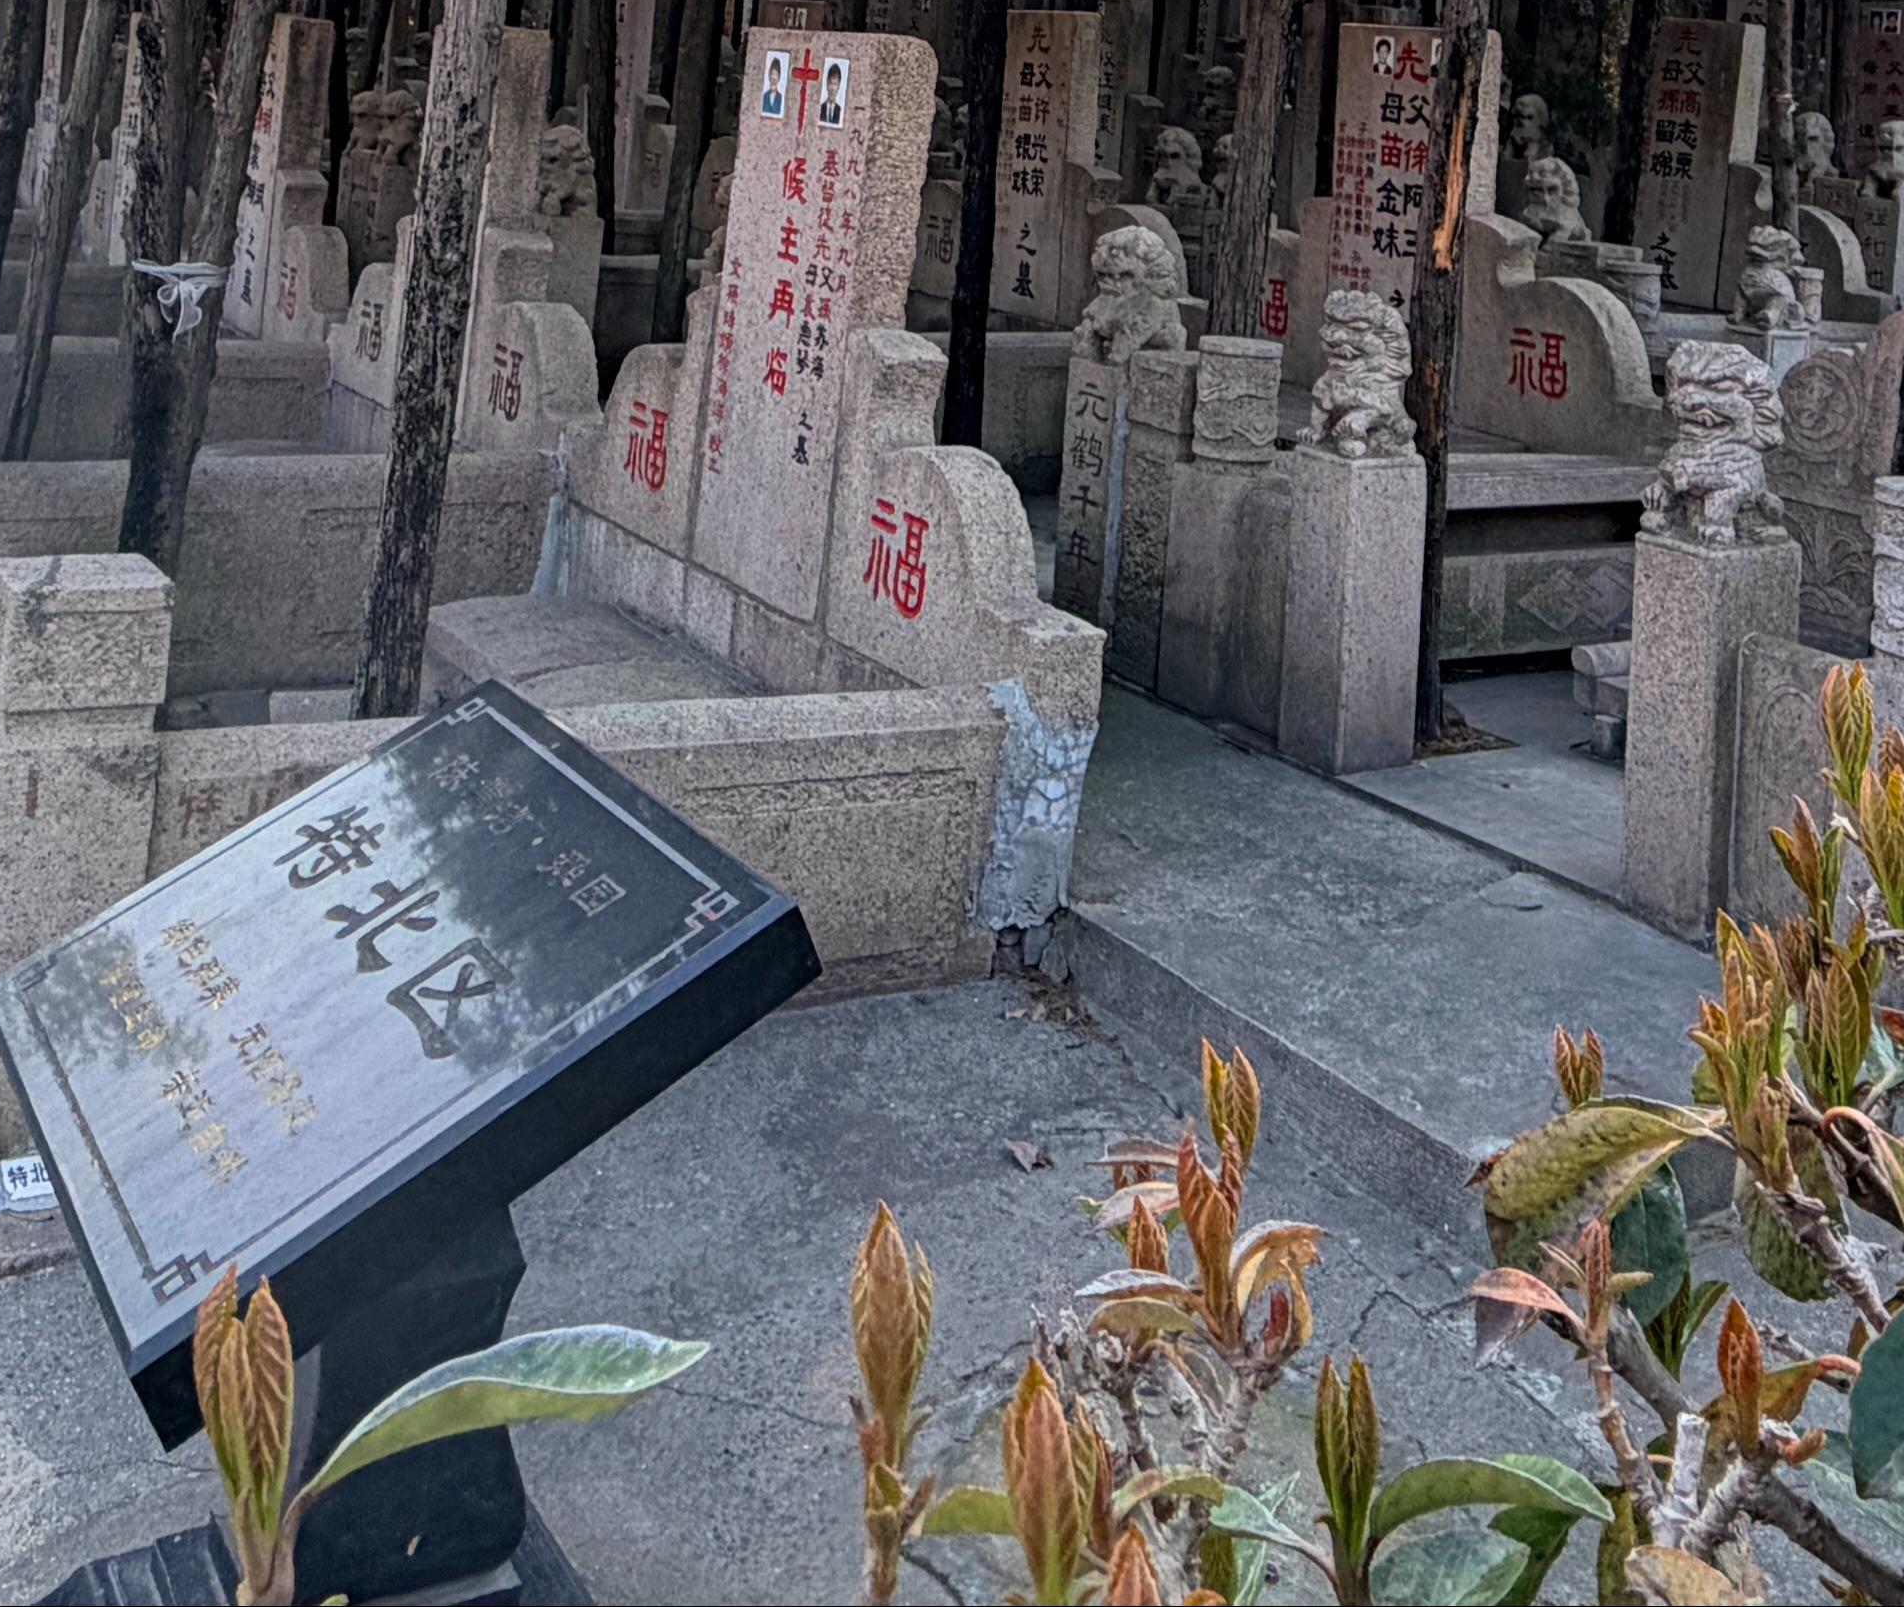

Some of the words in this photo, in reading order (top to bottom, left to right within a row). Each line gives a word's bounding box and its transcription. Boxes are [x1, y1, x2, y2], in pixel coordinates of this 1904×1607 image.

[1027, 26, 1050, 55] 先
[1394, 41, 1428, 83] 先
[1676, 27, 1700, 56] 先
[925, 215, 954, 264] 福
[356, 300, 384, 362] 福
[489, 343, 523, 422] 福
[1508, 327, 1567, 400] 福
[623, 401, 668, 491] 福
[863, 498, 930, 619] 福
[274, 806, 514, 1059] 特北区
[7, 1163, 51, 1190] 特北
